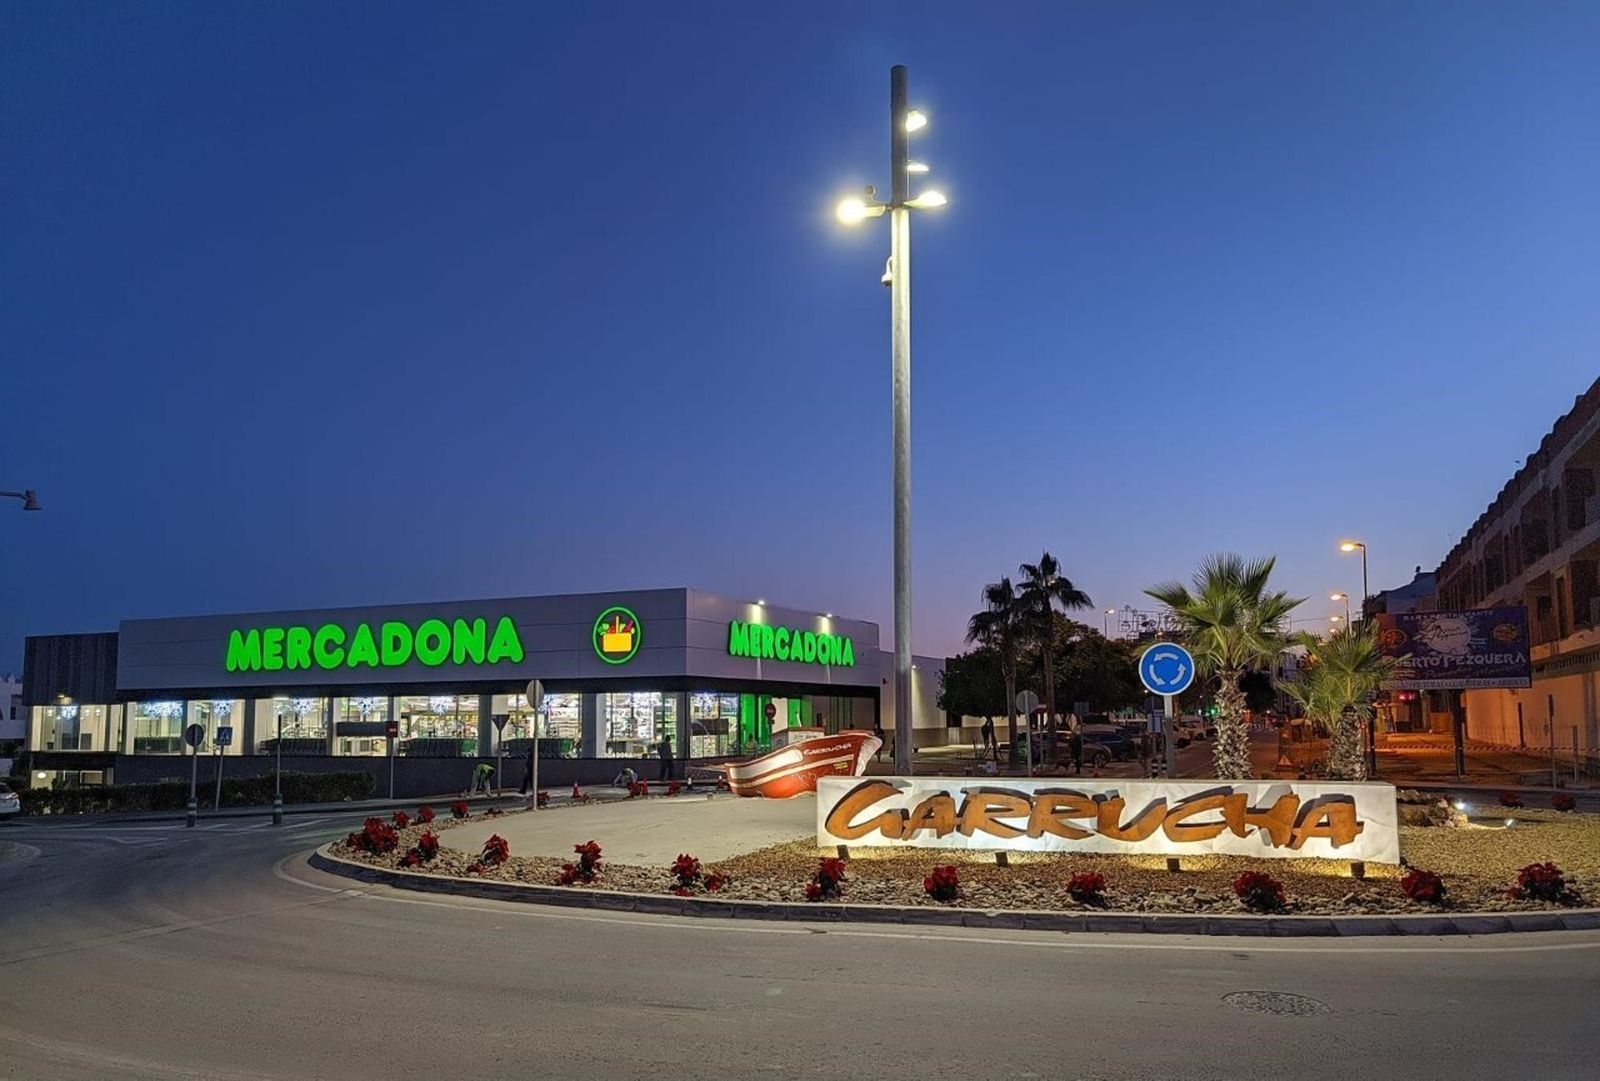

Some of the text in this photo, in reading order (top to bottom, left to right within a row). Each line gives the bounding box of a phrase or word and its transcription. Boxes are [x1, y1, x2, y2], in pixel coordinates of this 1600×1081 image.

[226, 616, 524, 672] MERCADONA
[729, 620, 855, 667] MERCADONA
[1443, 650, 1527, 668] PEZQUERA
[824, 778, 1365, 850] GARRUCHA
